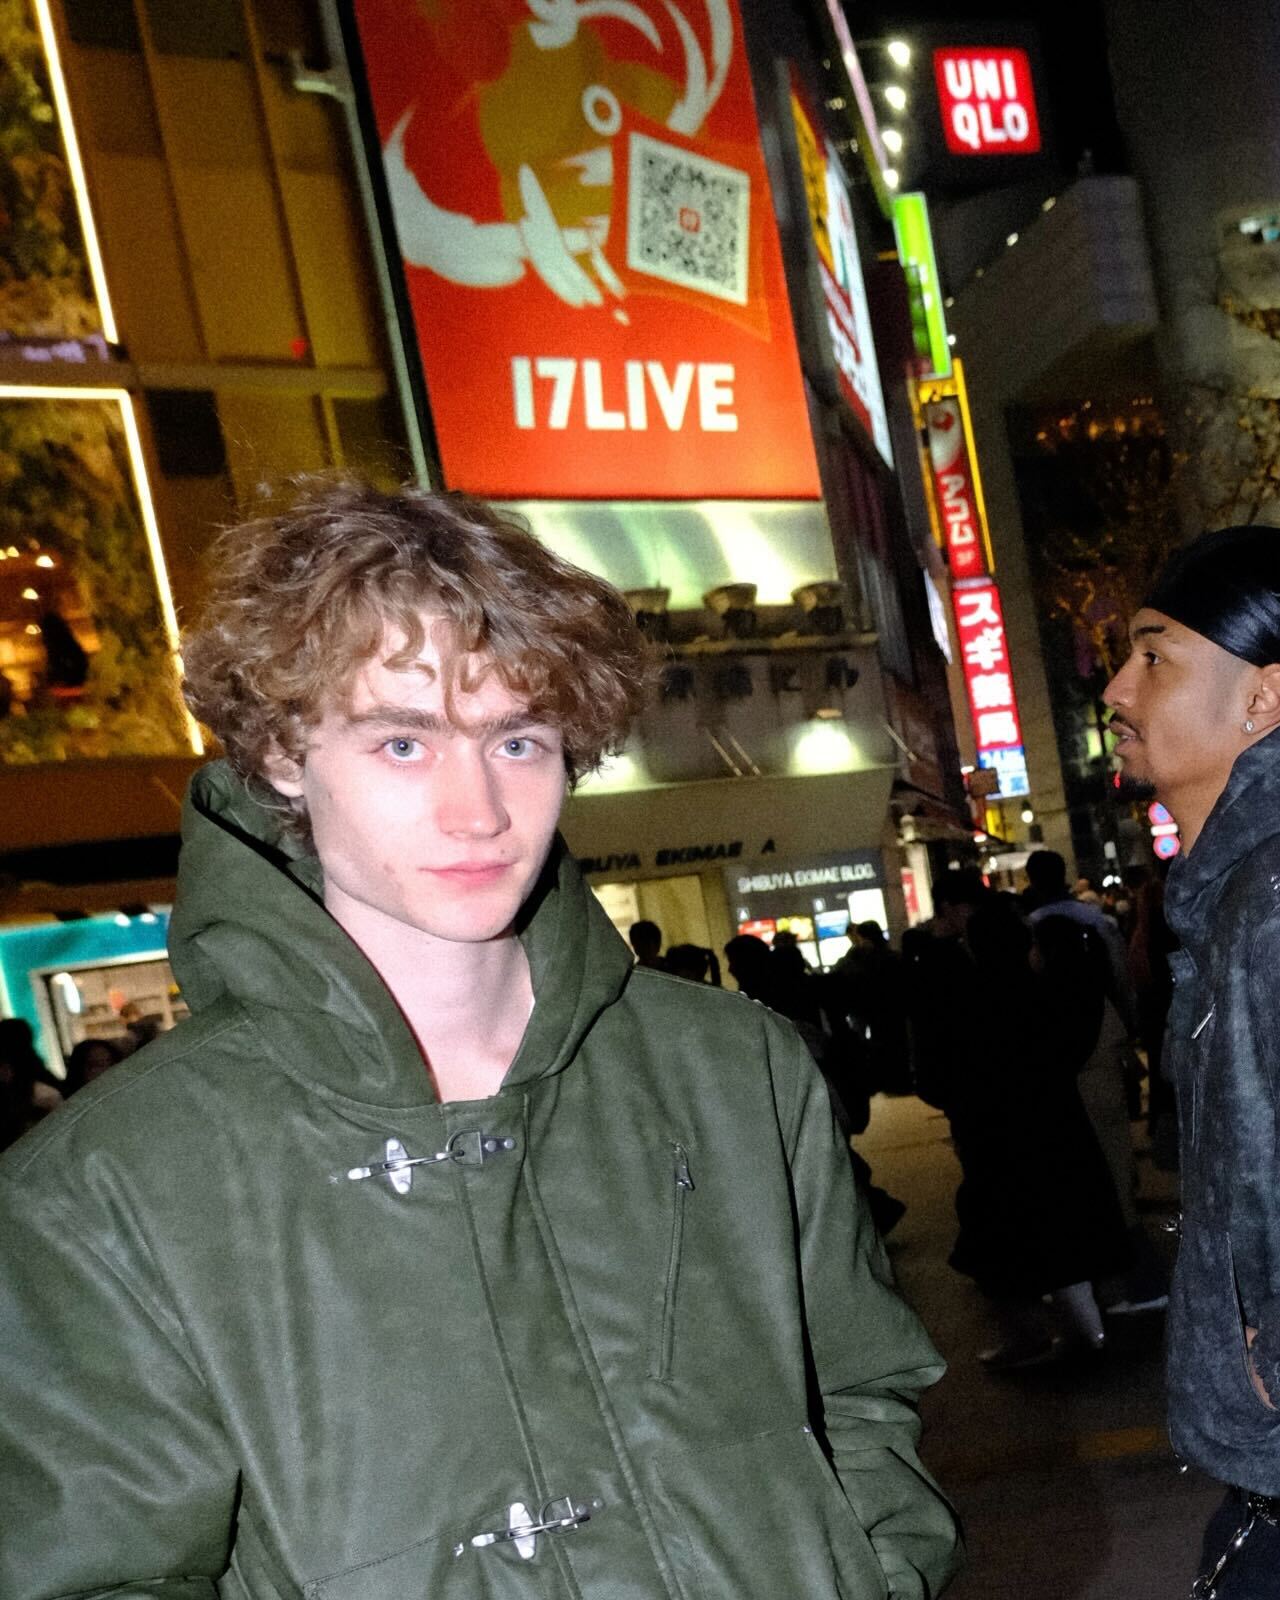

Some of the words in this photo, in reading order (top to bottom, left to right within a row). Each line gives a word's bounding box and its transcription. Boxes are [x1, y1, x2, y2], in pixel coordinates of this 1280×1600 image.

[943, 58, 1017, 100] UNI
[951, 102, 1030, 149] QLO
[511, 356, 739, 432] 17LIVE
[737, 872, 795, 894] SHIBUYA
